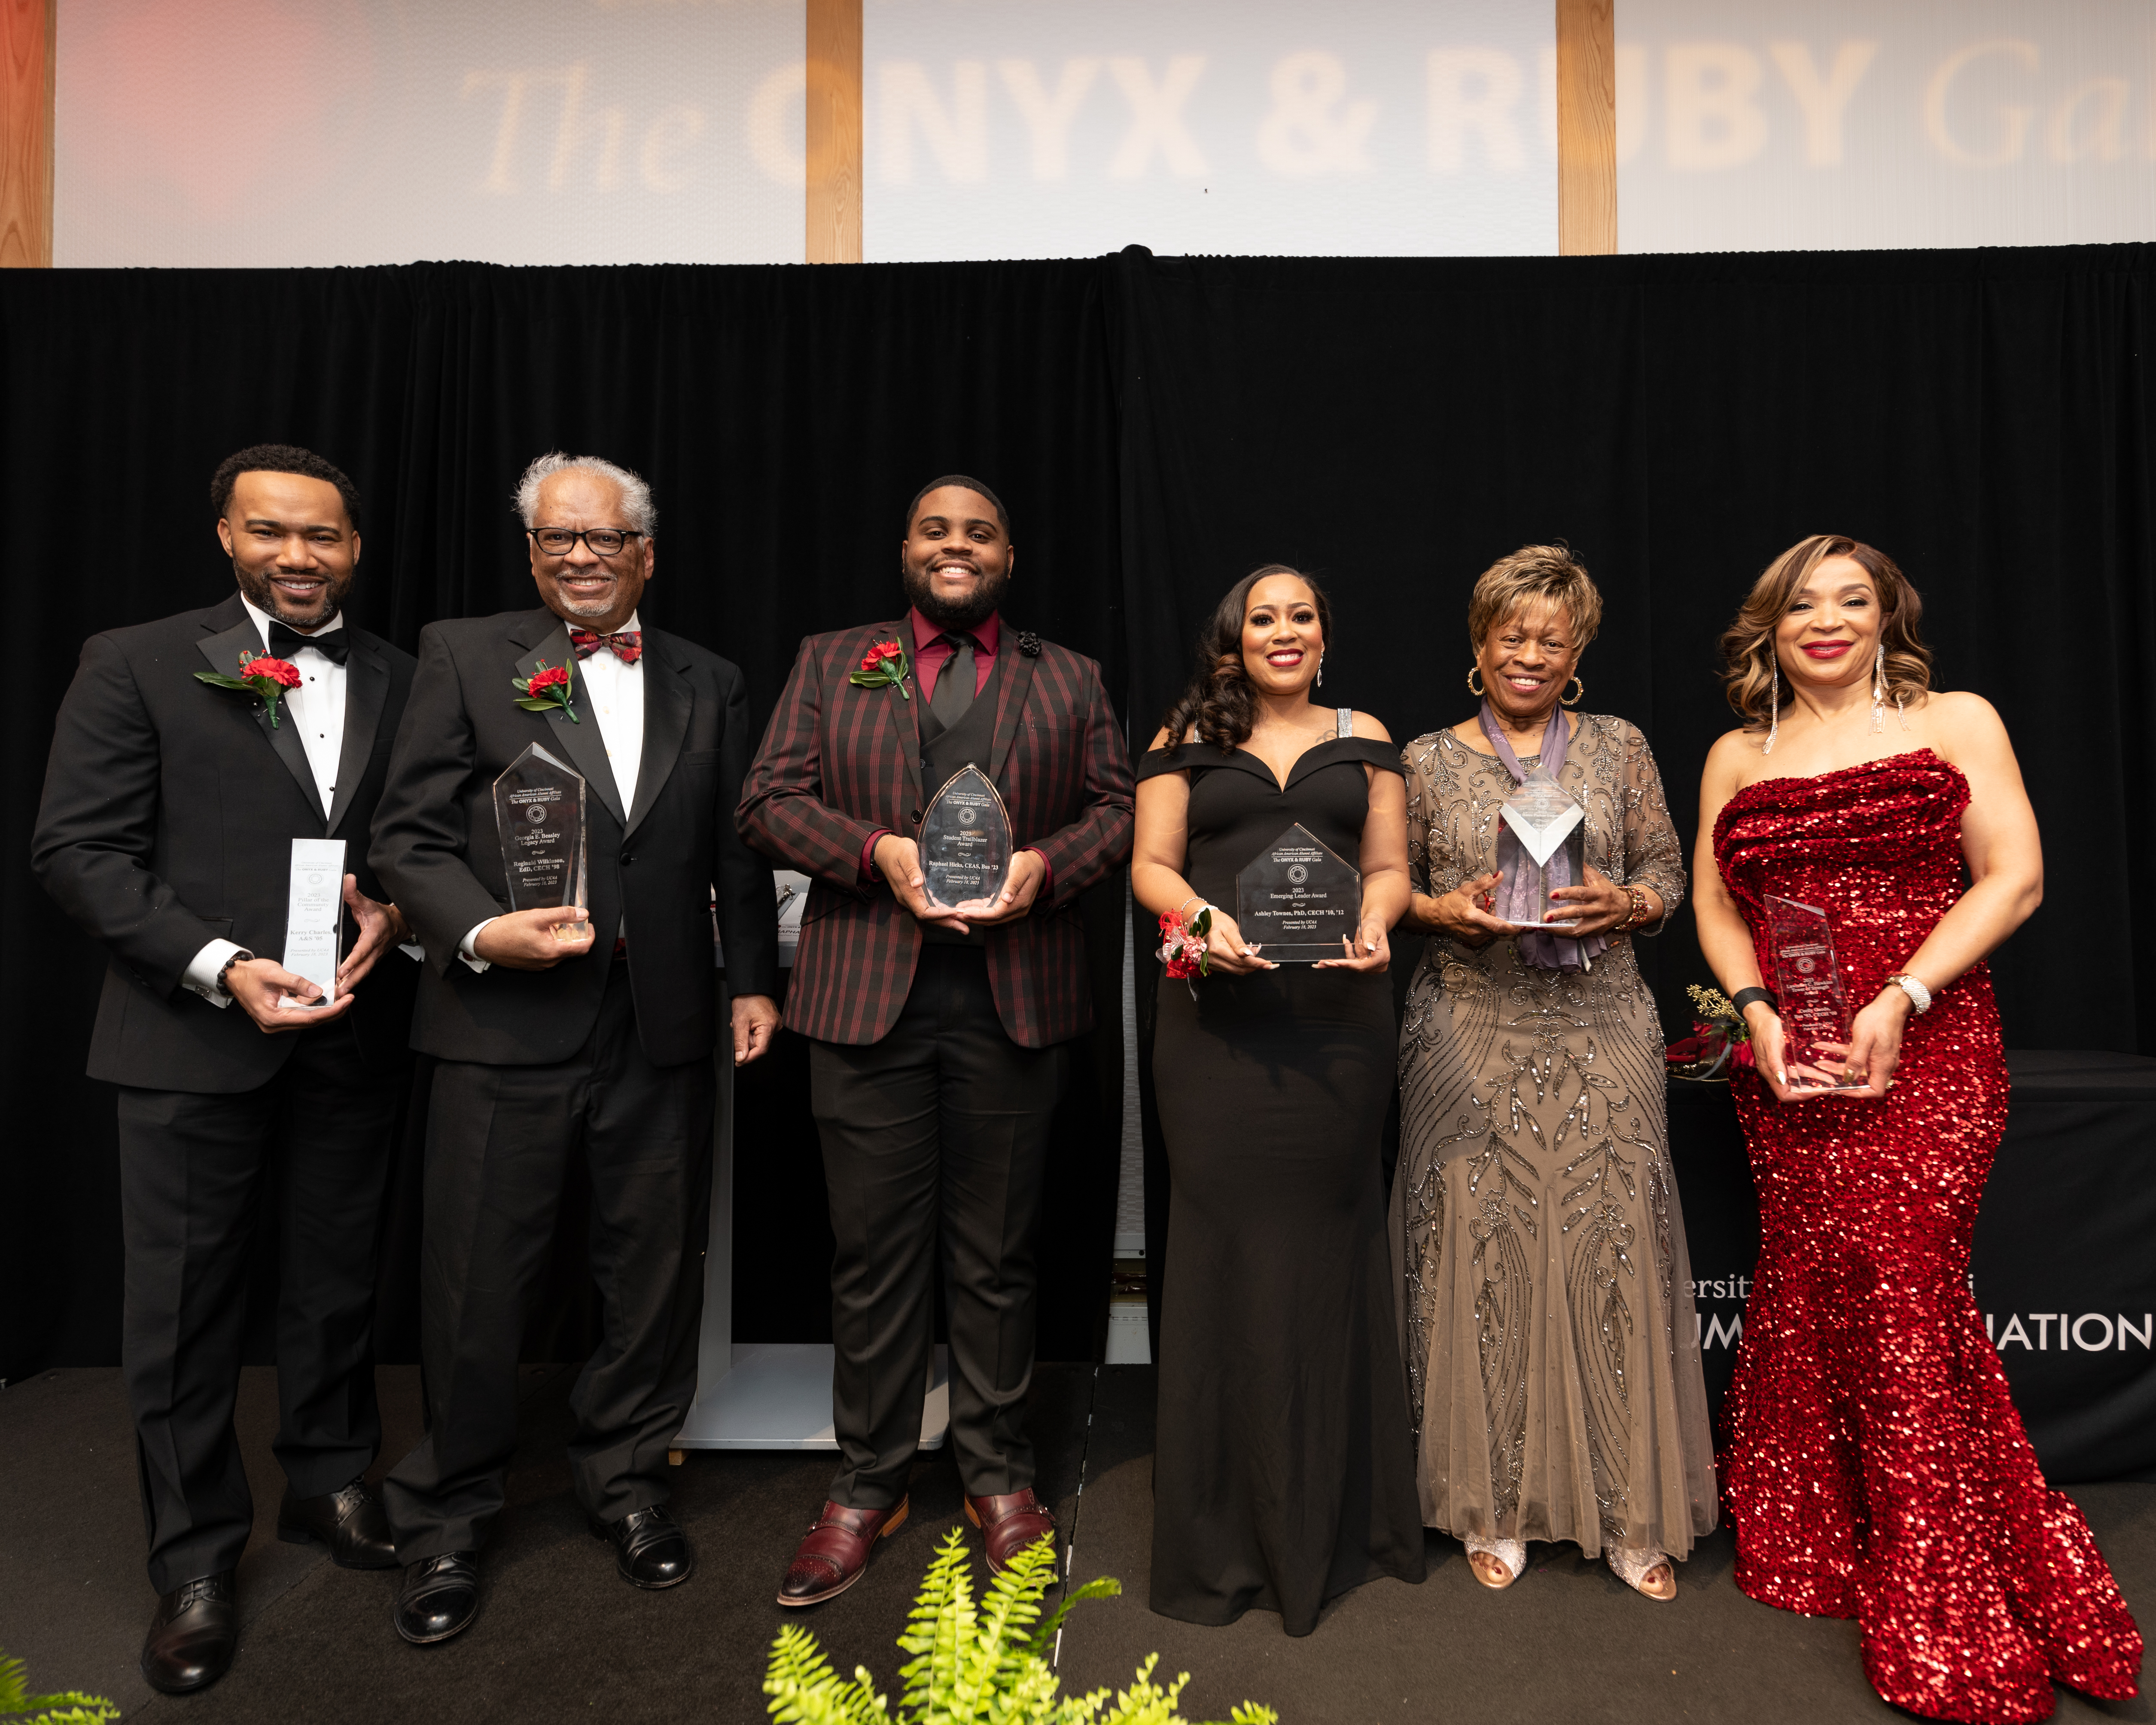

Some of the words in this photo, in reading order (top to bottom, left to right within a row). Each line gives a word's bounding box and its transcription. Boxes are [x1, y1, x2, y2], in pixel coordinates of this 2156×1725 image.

[459, 57, 706, 195] The
[747, 54, 1209, 190] ONYX
[1255, 50, 1379, 176] &
[1425, 37, 1880, 175] RUBY
[1684, 1274, 1754, 1298] ersit
